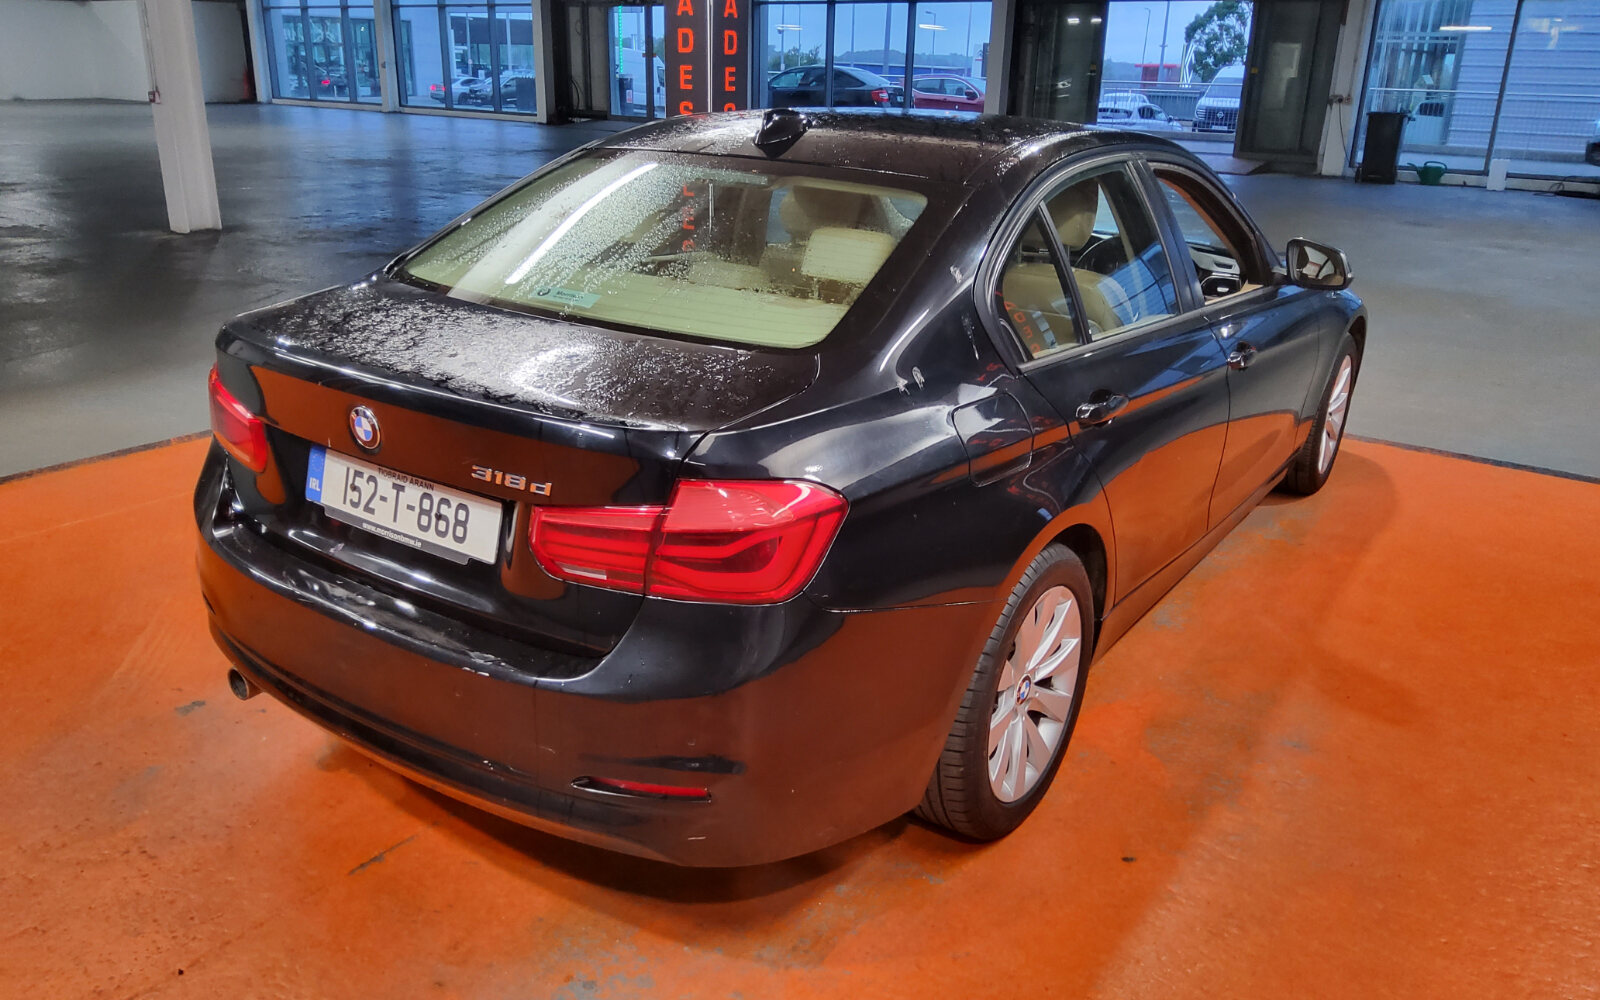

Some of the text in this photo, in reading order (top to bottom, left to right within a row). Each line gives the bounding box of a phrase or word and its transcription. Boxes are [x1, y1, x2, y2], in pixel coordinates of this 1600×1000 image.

[309, 477, 321, 491] IRL
[378, 467, 434, 491] TIOBRAID ARANN
[471, 464, 552, 496] 318d
[343, 466, 470, 544] 152-T-868
[362, 522, 422, 548] www.morrisonbmw.ie
